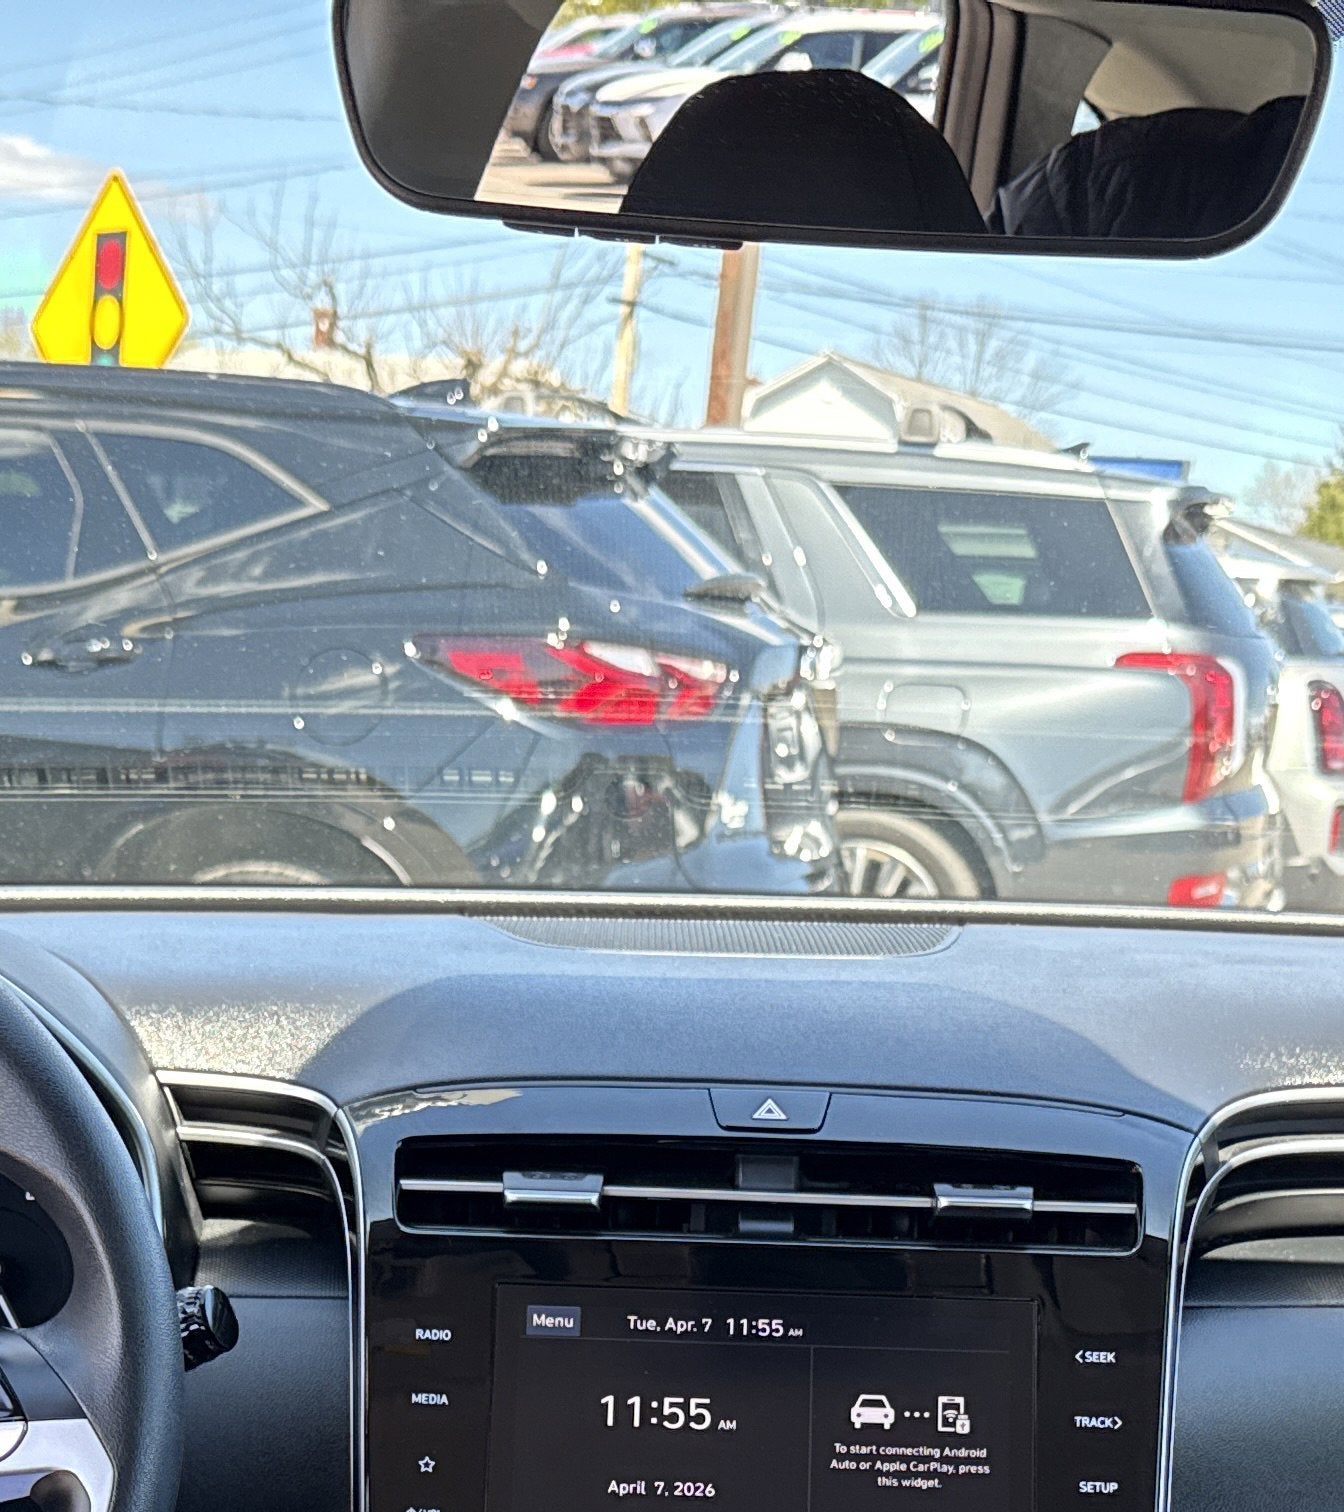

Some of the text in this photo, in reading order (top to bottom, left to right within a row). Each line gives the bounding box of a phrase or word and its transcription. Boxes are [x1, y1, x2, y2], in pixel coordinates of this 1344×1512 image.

[532, 1313, 574, 1329] Menu
[664, 1317, 697, 1335] Apr.
[702, 1318, 713, 1334] 7
[726, 1318, 784, 1337] 11:55
[788, 1328, 803, 1337] AM
[415, 1328, 452, 1341] RADIO
[411, 1393, 449, 1406] MEDIA
[600, 1395, 737, 1431] 11:55 AM
[834, 1443, 986, 1458] To start connecting Android
[830, 1459, 856, 1469] Auto
[859, 1461, 872, 1470] or
[874, 1460, 907, 1472] Apple
[958, 1464, 990, 1474] press
[607, 1480, 716, 1497] April 7, 2026
[877, 1477, 942, 1489] this widget.
[1079, 1481, 1118, 1493] SETUP
